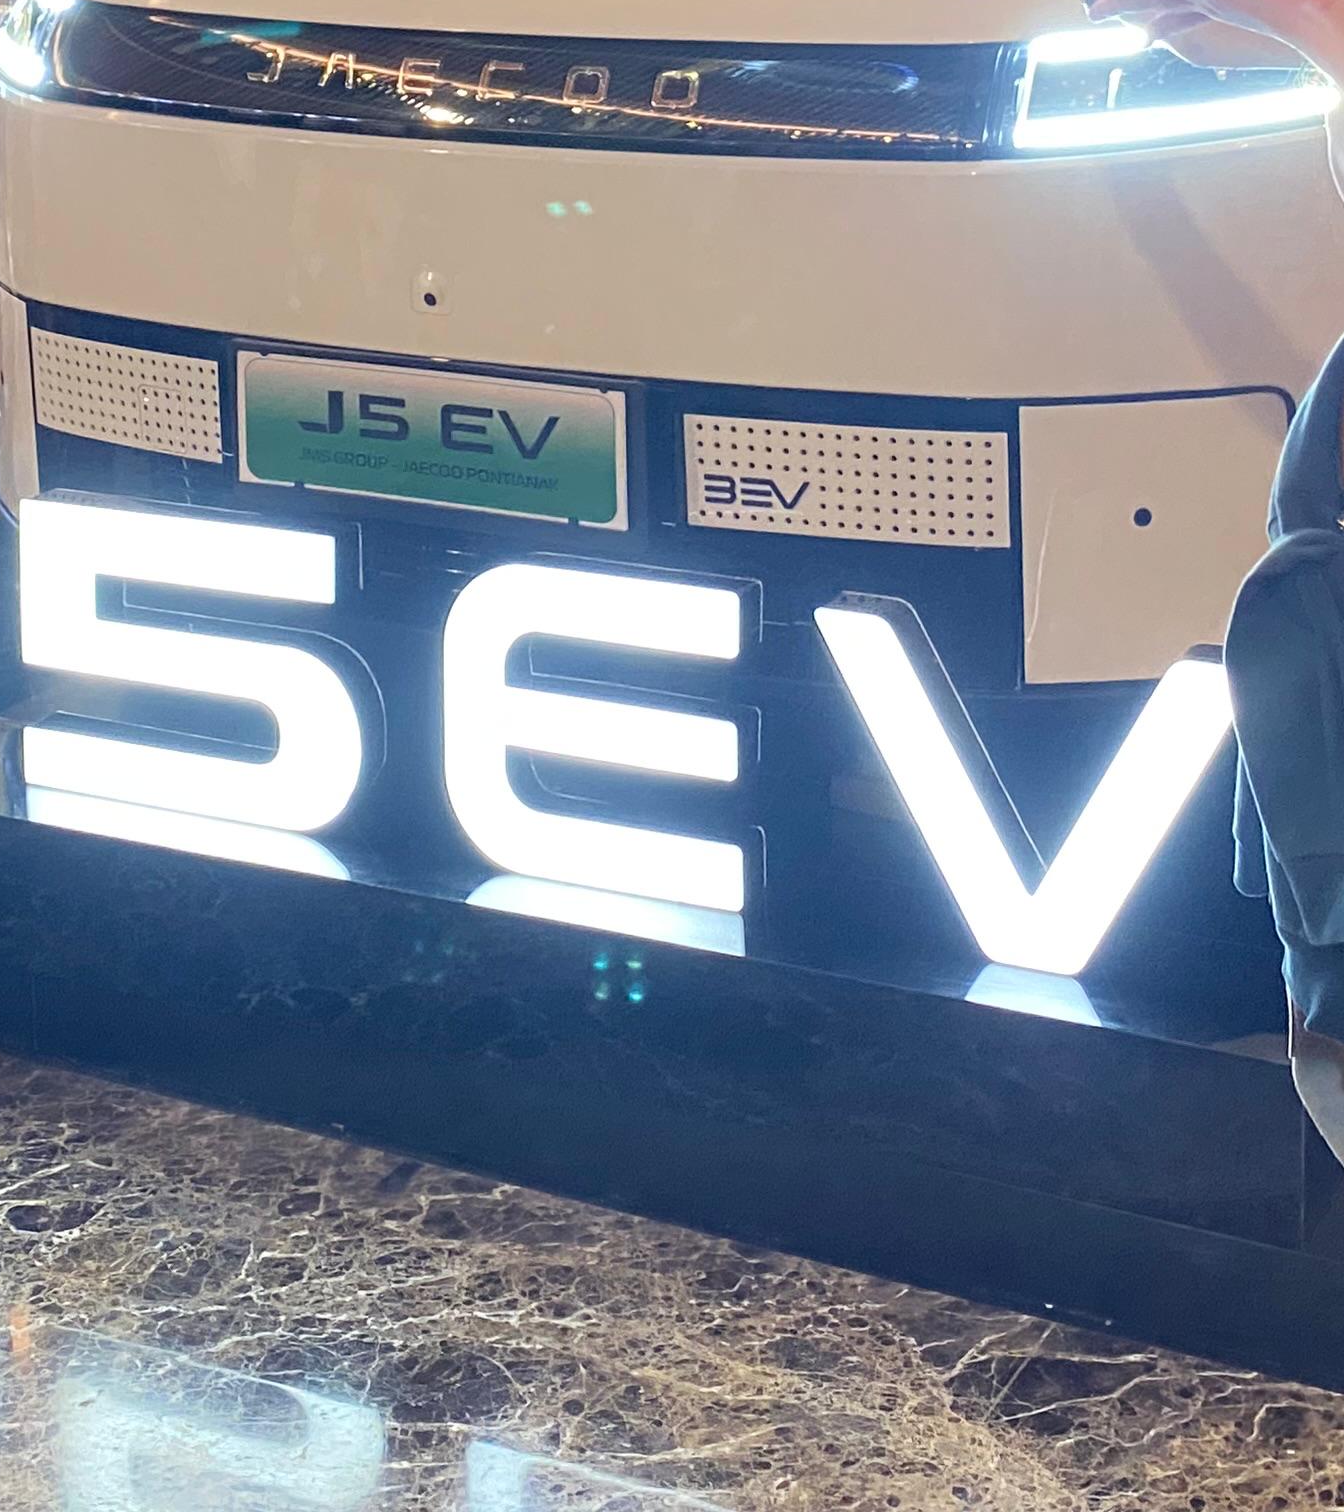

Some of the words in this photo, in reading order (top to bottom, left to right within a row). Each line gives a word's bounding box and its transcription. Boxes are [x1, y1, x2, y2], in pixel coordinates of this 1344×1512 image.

[247, 47, 700, 110] JAECOO
[298, 391, 410, 441] J5
[440, 404, 560, 460] EV
